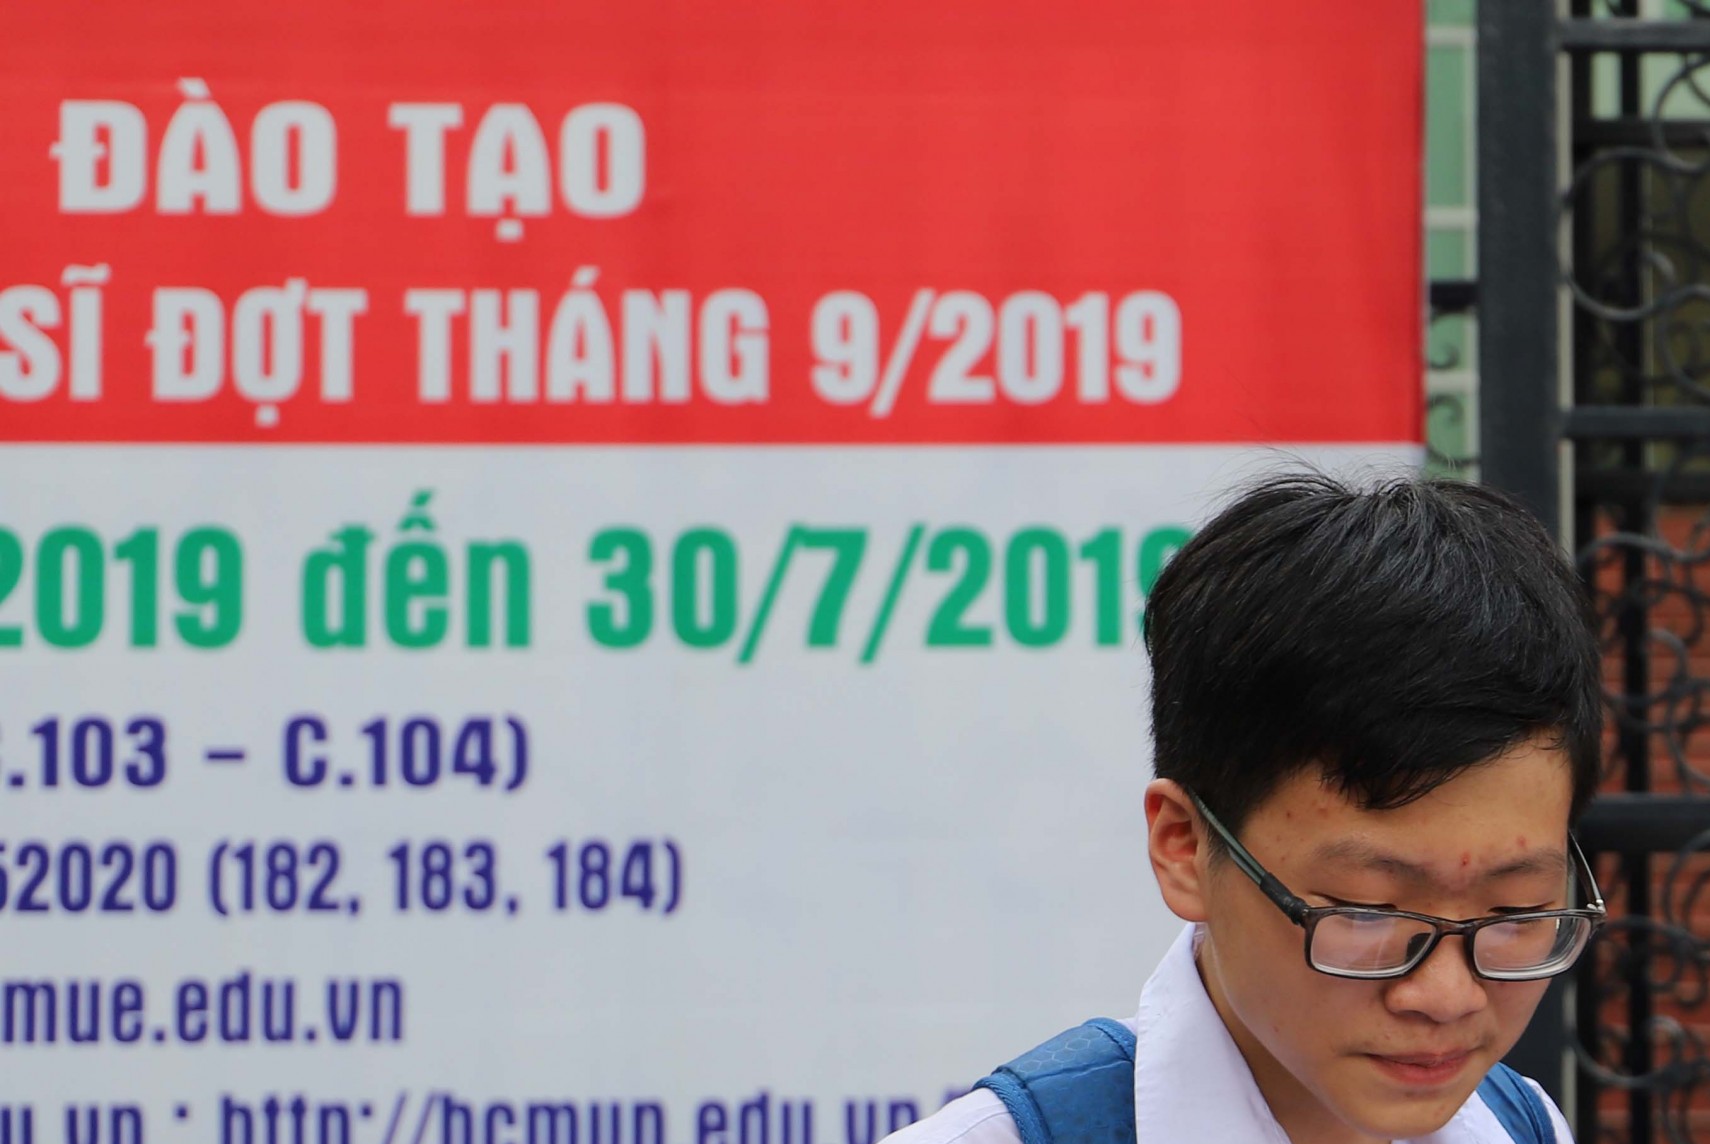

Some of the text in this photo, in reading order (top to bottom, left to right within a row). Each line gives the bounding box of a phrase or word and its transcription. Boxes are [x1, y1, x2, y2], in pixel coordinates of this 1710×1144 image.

[50, 79, 645, 240] ĐÀO TẠO
[0, 265, 1181, 425] SĨ ĐỢT THÁNG 9/2019
[301, 491, 531, 650] đến
[0, 716, 167, 789] .103
[282, 714, 529, 792] C.104)
[0, 839, 682, 916] 2020 (182, 183, 184)
[2, 970, 403, 1044] mue.edu.vn
